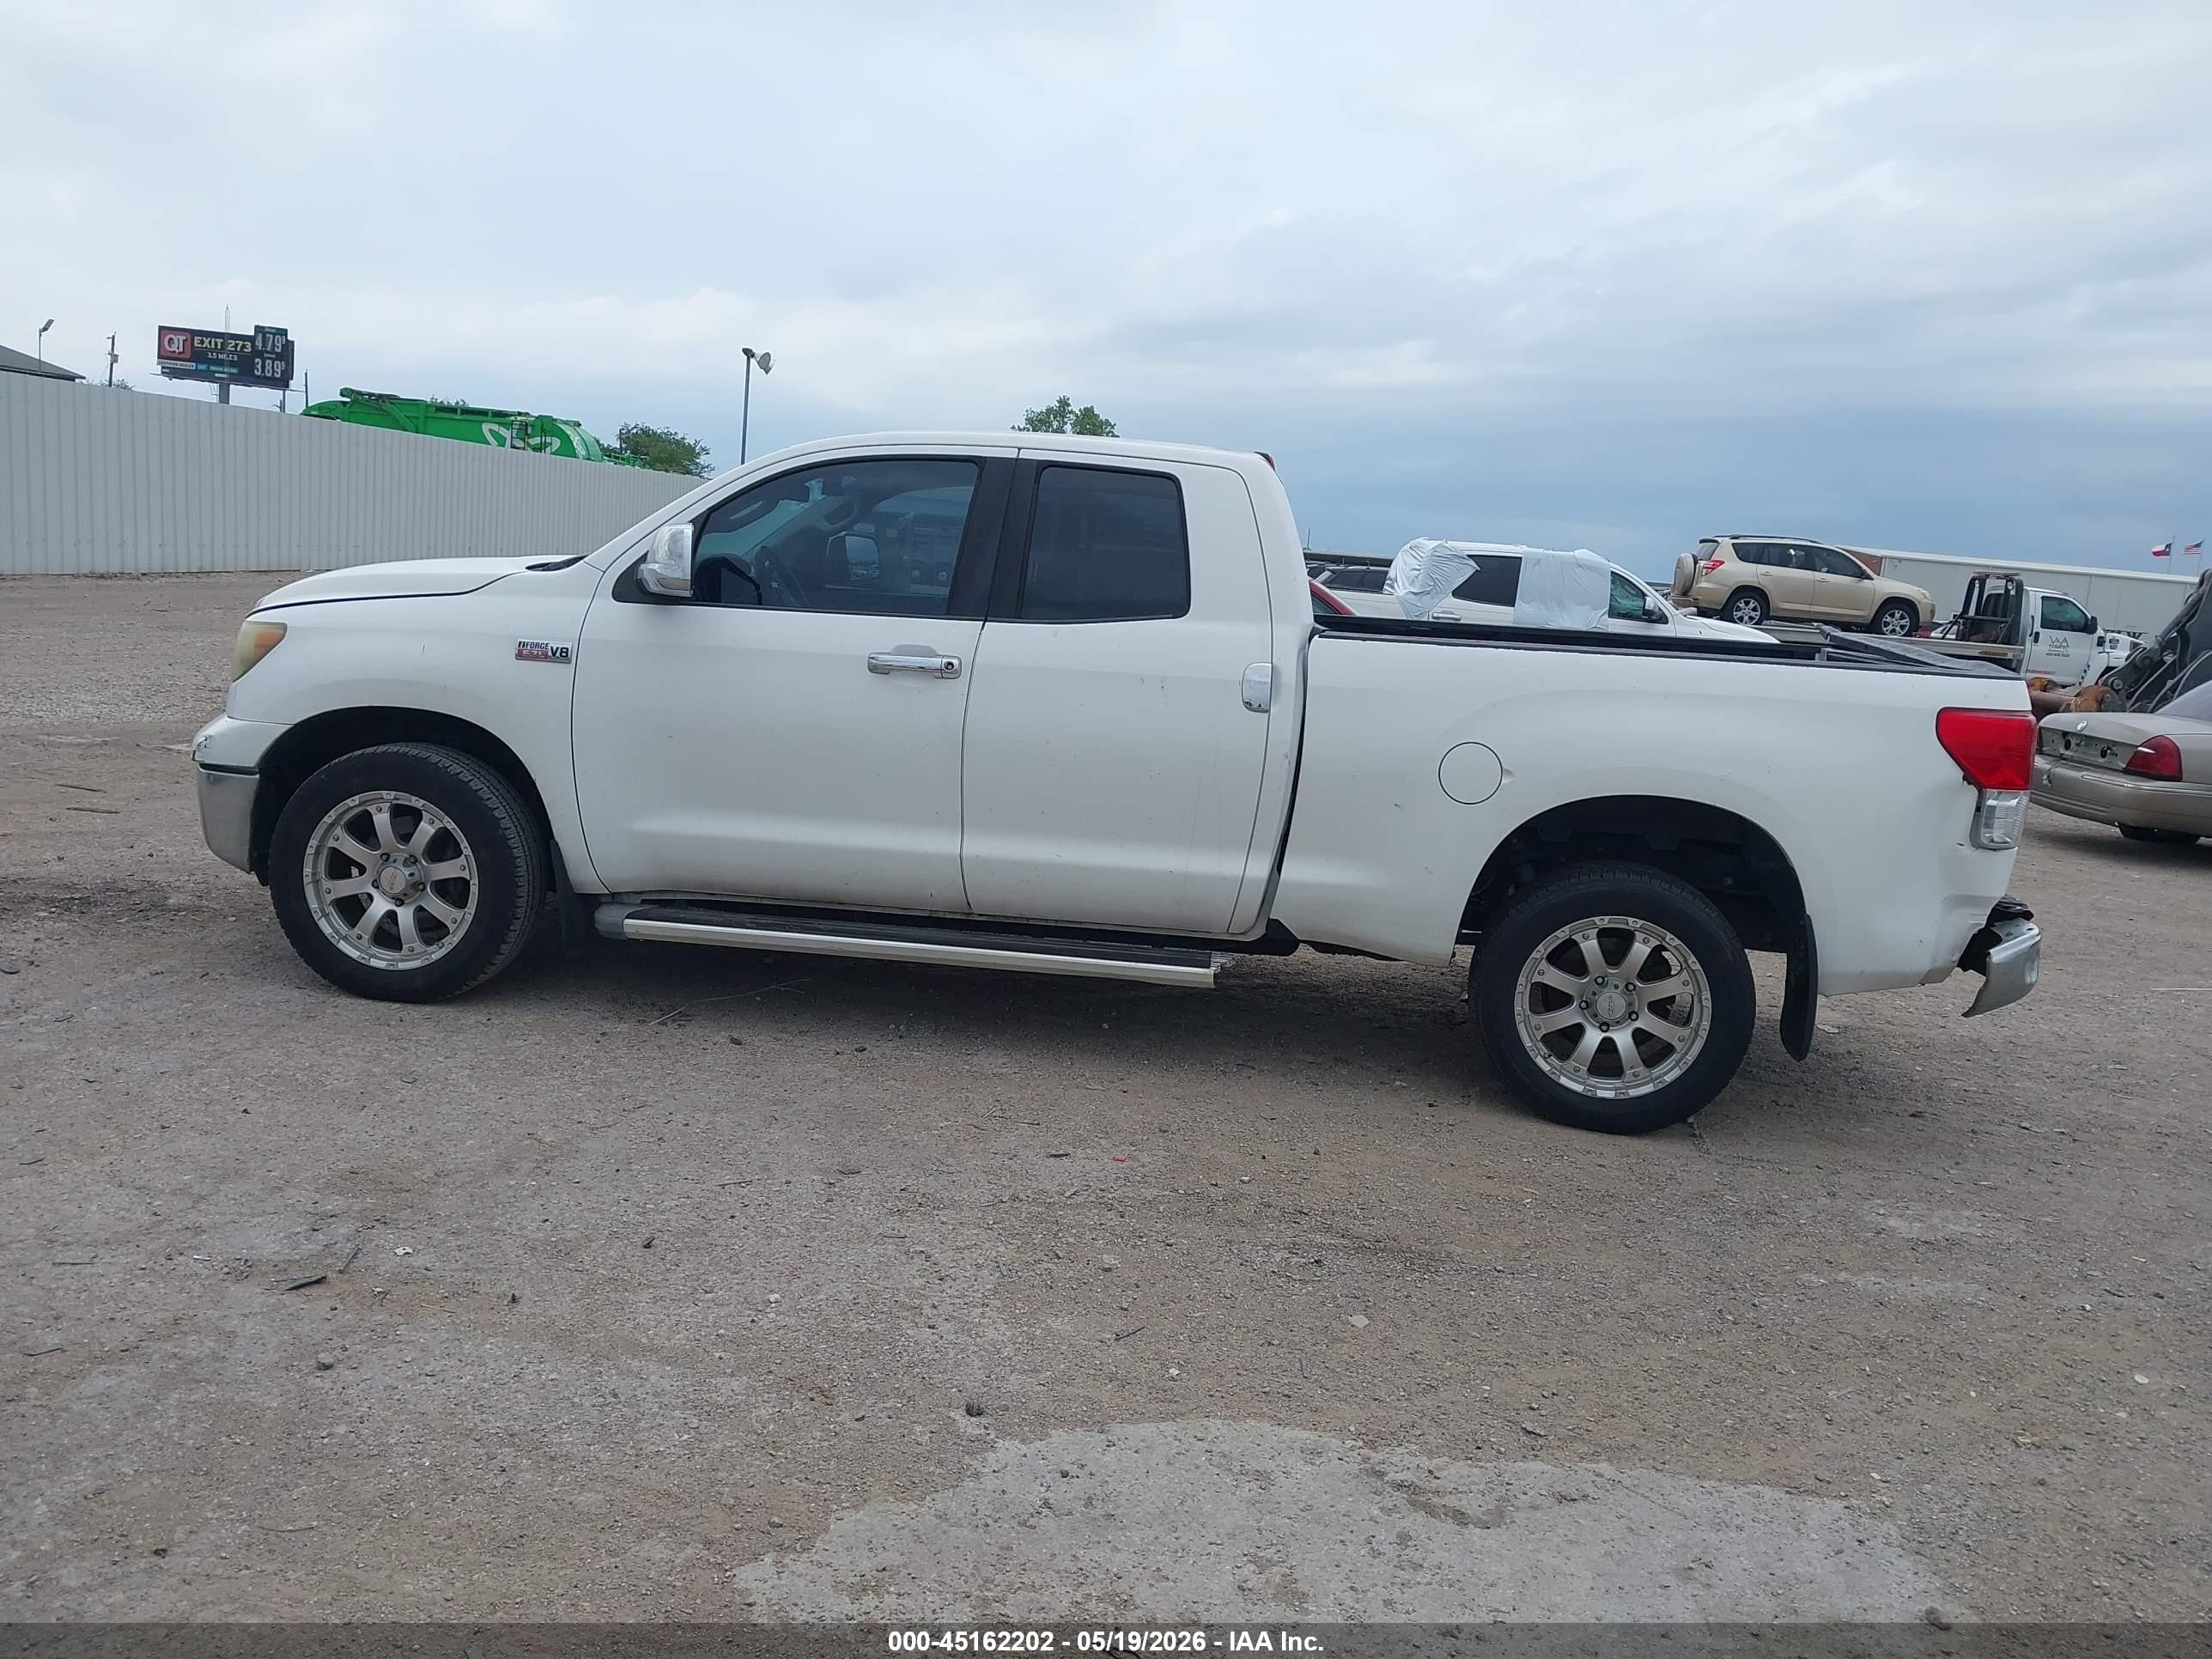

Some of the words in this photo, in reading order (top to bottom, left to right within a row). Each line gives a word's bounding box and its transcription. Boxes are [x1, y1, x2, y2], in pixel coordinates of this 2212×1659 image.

[164, 334, 187, 354] QT
[194, 336, 224, 349] EXIT
[227, 339, 252, 352] 273
[218, 353, 239, 362] MILES
[550, 645, 569, 658] V8
